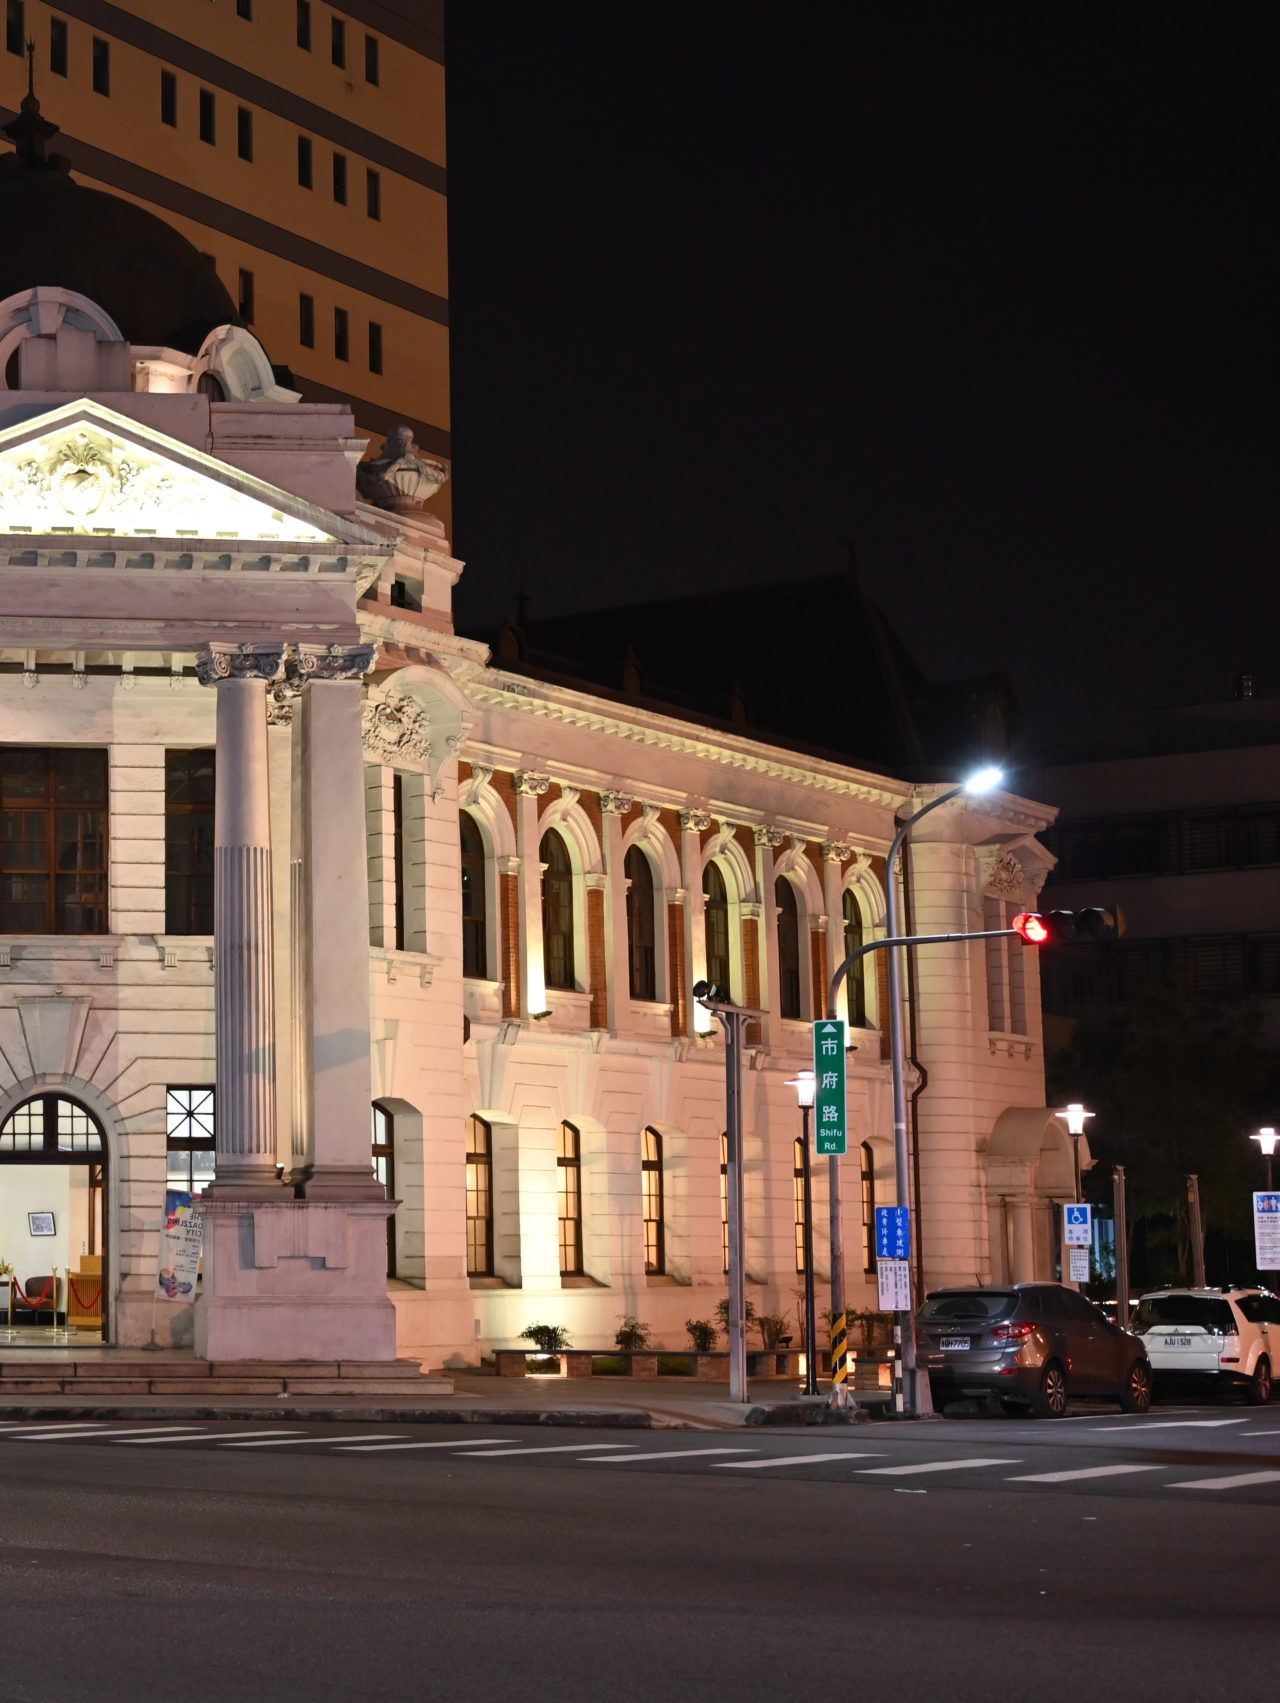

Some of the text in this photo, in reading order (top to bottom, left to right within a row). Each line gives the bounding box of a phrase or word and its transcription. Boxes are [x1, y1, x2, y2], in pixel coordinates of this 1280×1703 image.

[821, 1037, 838, 1122] 市府路
[819, 1128, 842, 1137] Shifu
[824, 1142, 838, 1150] Rd.
